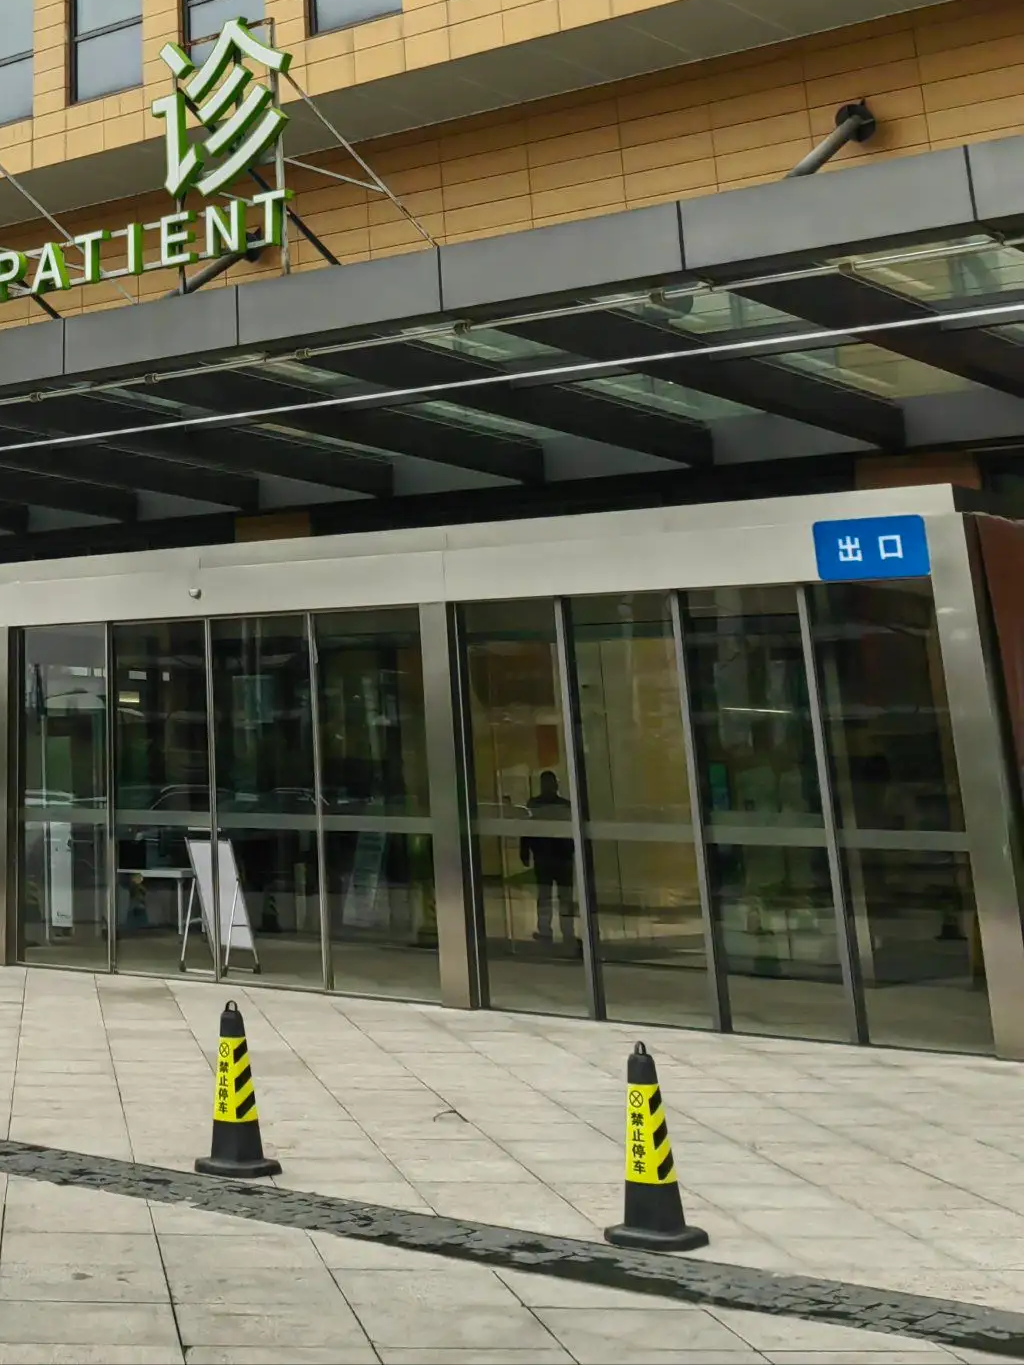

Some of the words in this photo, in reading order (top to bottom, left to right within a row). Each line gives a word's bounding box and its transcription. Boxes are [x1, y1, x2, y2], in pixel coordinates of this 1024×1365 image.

[838, 534, 903, 562] 出口
[218, 1061, 230, 1114] 禁止停车
[630, 1112, 647, 1175] 禁止停车
